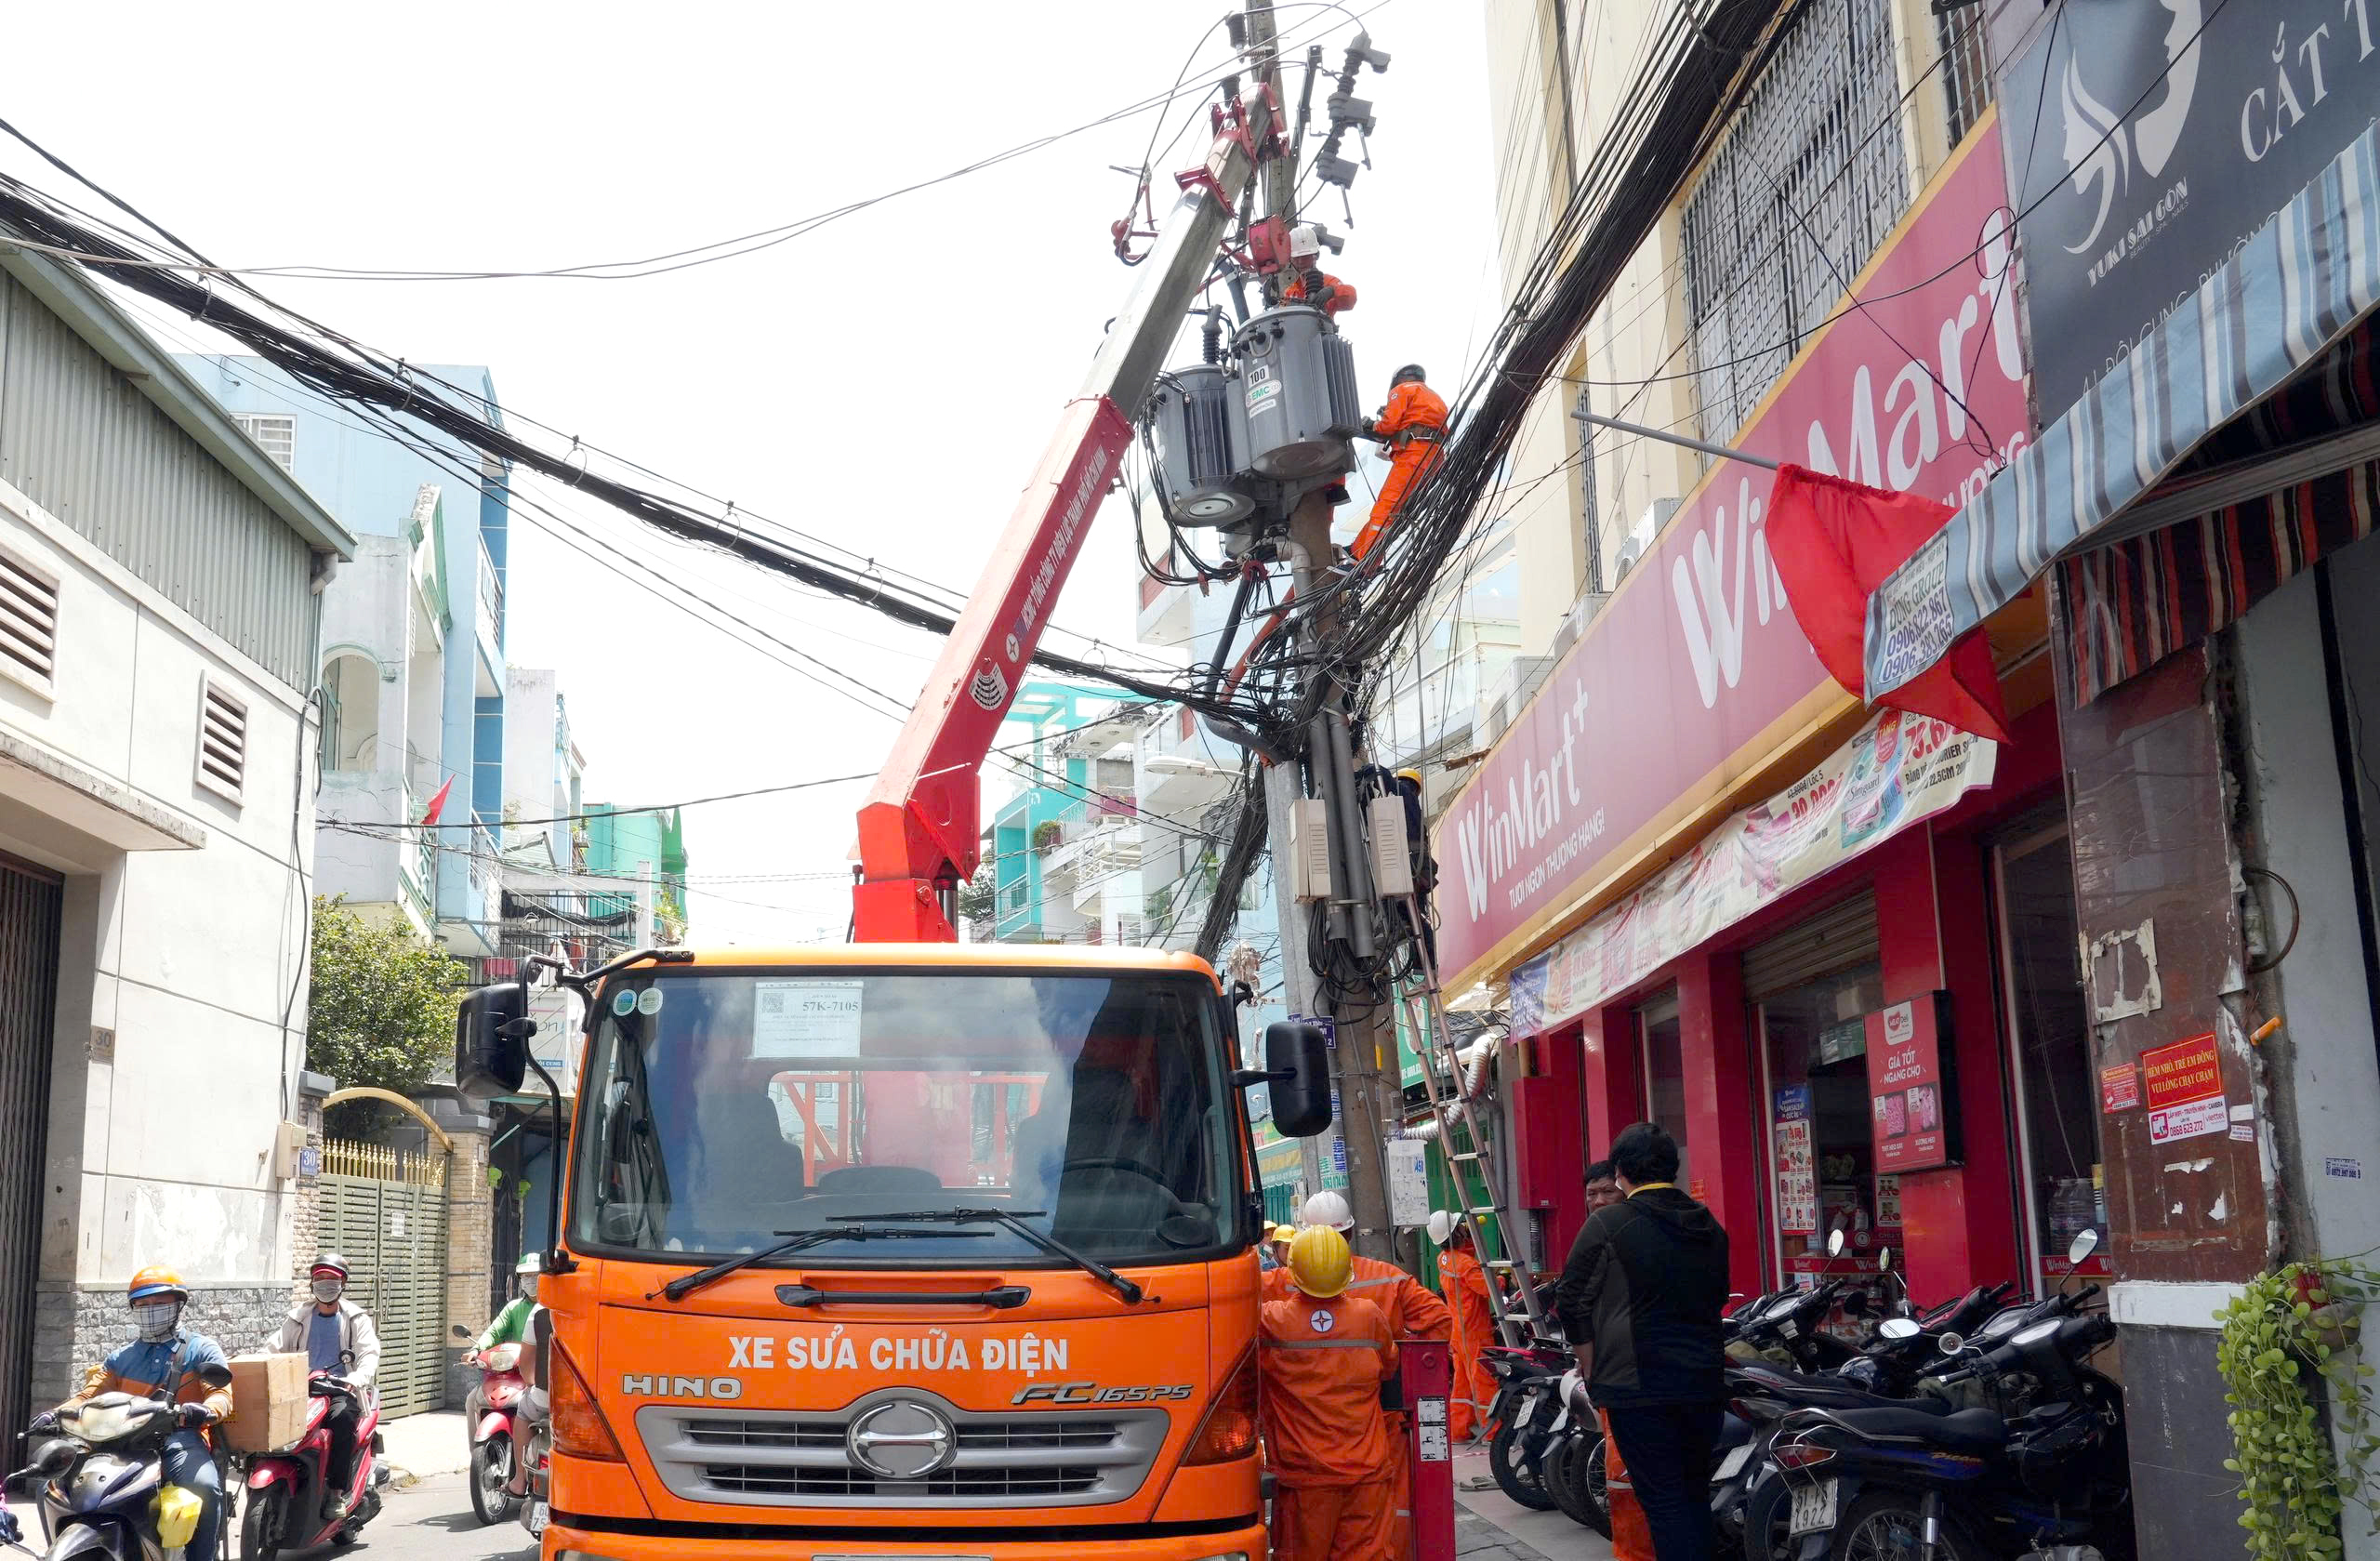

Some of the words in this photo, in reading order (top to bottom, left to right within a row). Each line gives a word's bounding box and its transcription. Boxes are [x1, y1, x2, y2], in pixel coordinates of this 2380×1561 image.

[2241, 20, 2329, 162] CẮT
[2087, 237, 2126, 287] YUKI
[1250, 368, 1265, 384] 100
[1251, 386, 1270, 401] EMC
[1673, 206, 2025, 709] WiMart
[1911, 562, 1945, 607] GROUP
[1524, 860, 1547, 897] NGON
[802, 1001, 859, 1012] 57K-7105
[2187, 1055, 2197, 1067] EM
[1884, 1067, 1906, 1085] NGANG
[2169, 1125, 2183, 1137] 0868
[2183, 1122, 2193, 1134] 623
[2194, 1120, 2203, 1131] 272
[303, 1151, 316, 1166] 30
[728, 1336, 774, 1369] XE
[787, 1324, 858, 1370] SỬA
[869, 1329, 971, 1371] CHỮA
[981, 1332, 1068, 1378] ĐIỆN
[623, 1374, 741, 1399] HINO
